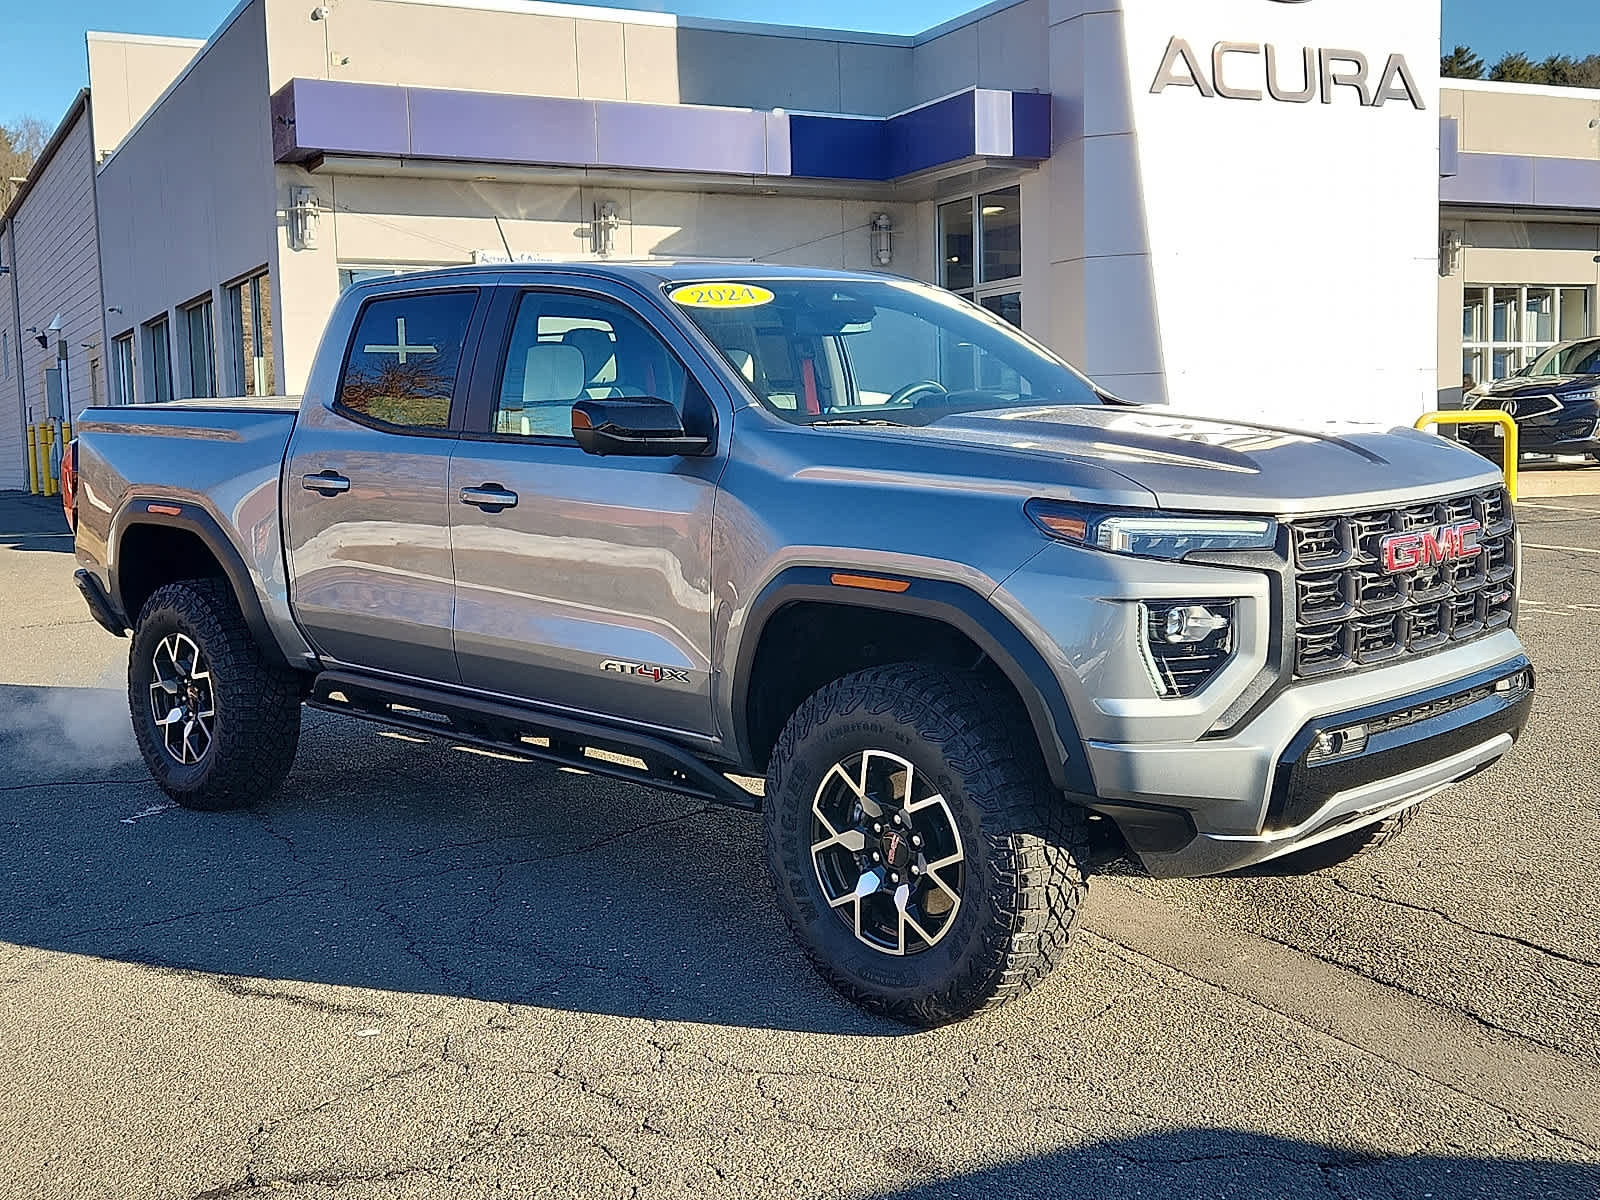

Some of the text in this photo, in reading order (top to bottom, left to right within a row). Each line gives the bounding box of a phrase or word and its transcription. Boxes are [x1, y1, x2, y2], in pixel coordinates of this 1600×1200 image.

[1149, 35, 1426, 110] ACURA
[690, 287, 756, 303] 2024
[1386, 521, 1482, 572] GMC
[599, 659, 691, 684] AT4X
